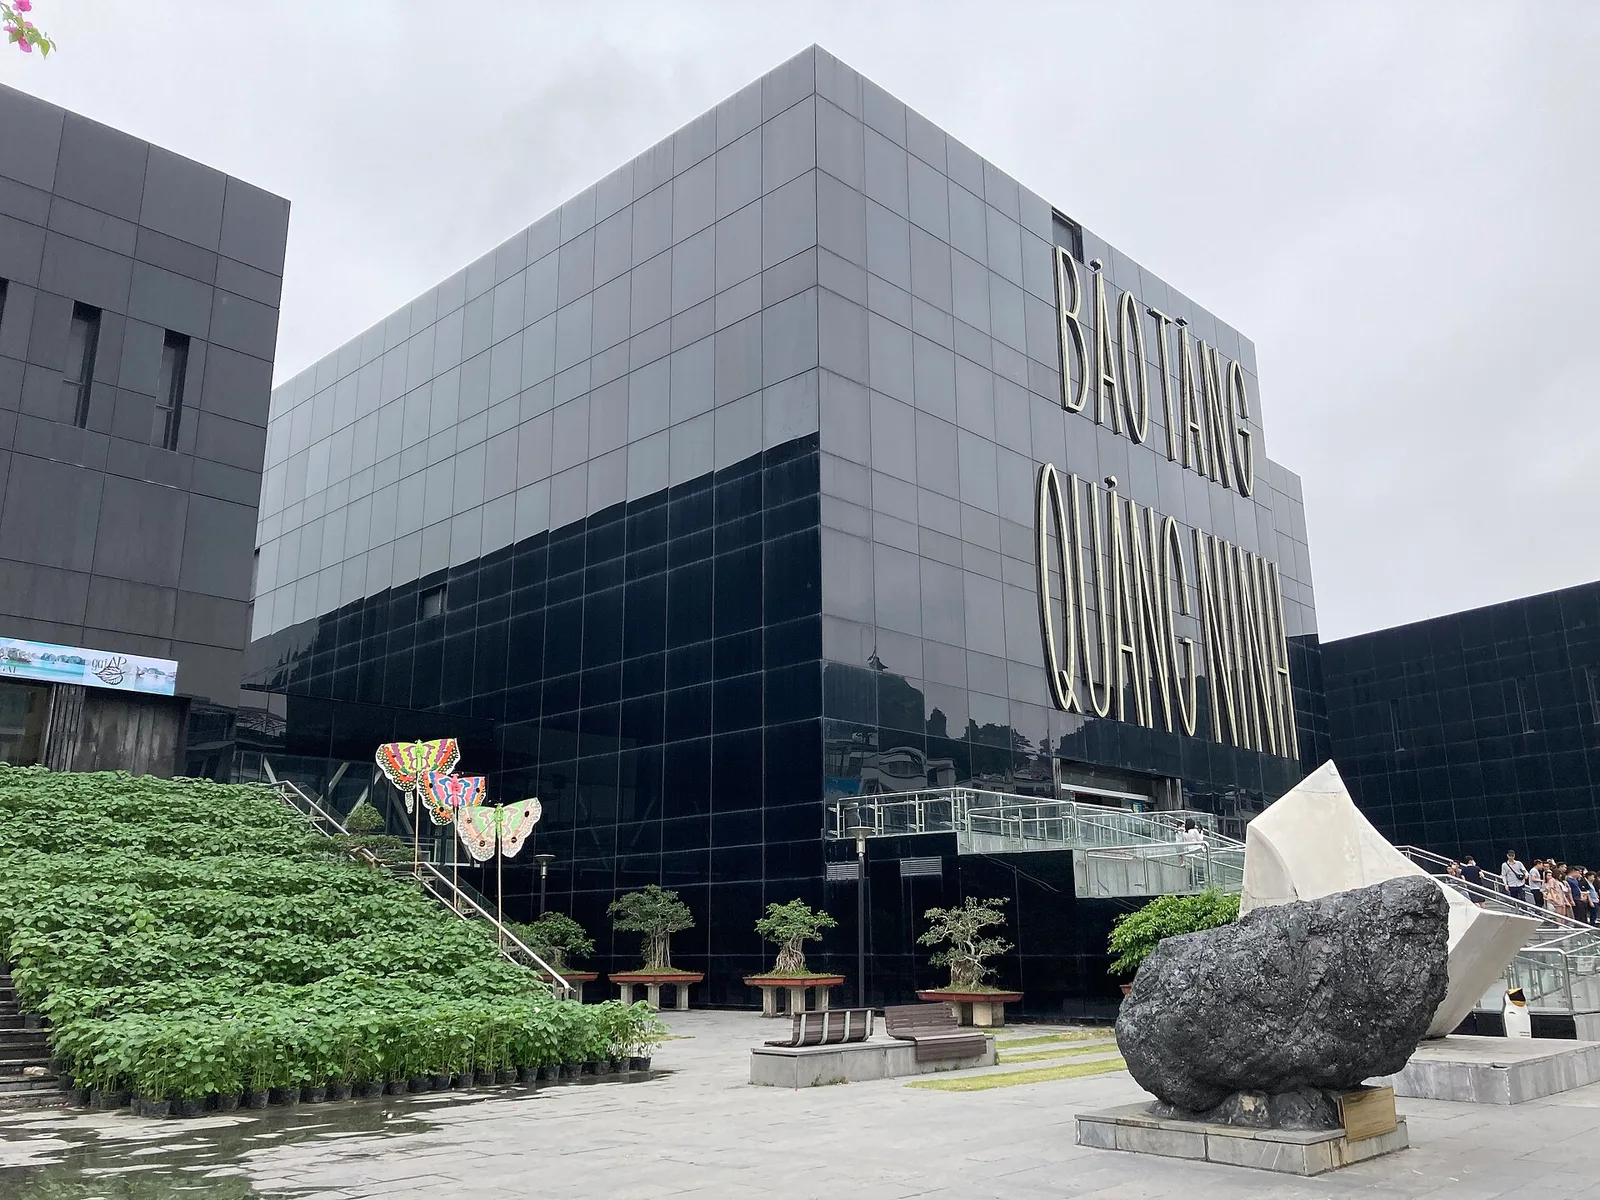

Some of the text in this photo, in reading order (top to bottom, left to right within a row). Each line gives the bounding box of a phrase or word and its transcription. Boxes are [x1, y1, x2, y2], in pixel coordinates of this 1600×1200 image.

[1052, 245, 1253, 498] BẢO TÀNG
[1035, 462, 1299, 760] QUẢNG NINH
